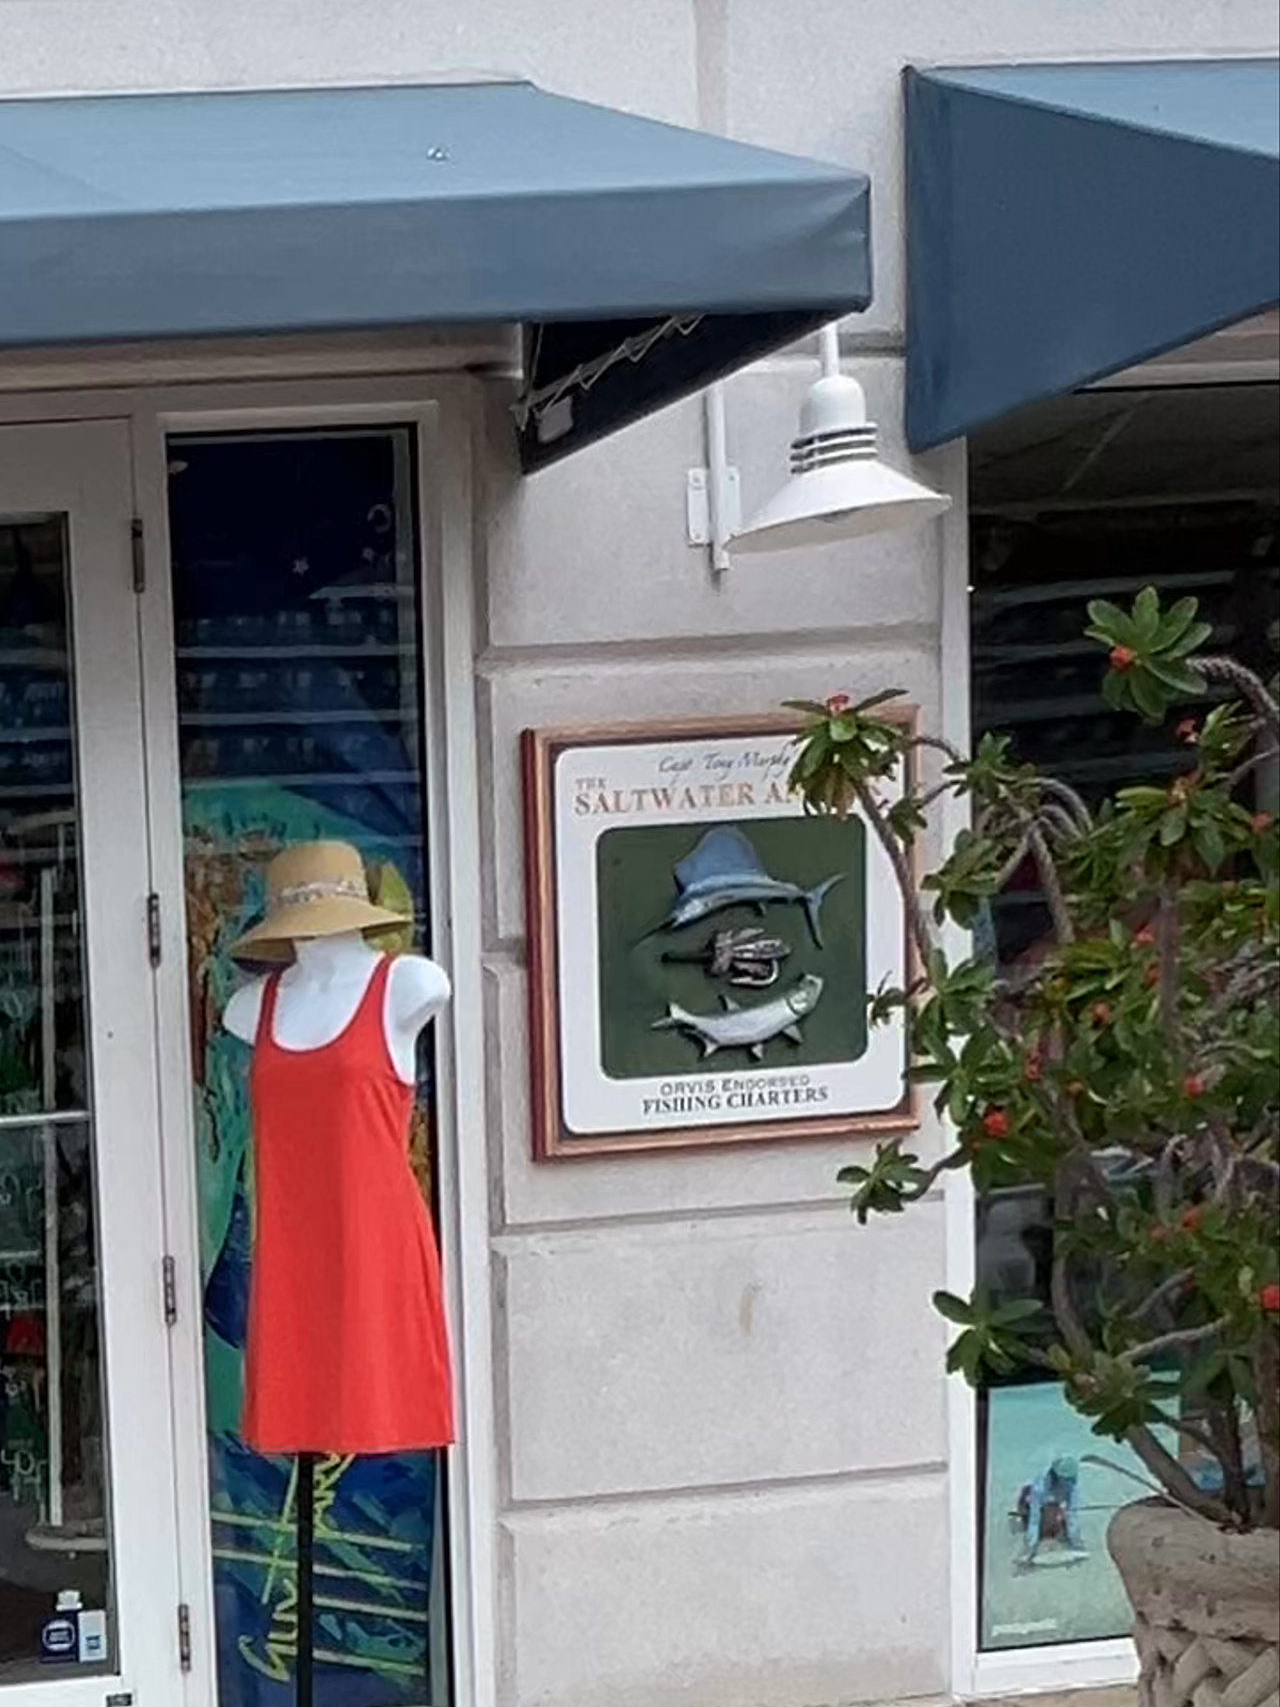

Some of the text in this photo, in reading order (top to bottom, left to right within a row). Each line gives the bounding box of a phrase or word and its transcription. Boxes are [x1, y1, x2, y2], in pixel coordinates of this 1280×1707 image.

[575, 777, 606, 791] THE
[574, 781, 755, 816] SALTWATER
[660, 1073, 811, 1097] ORVIS ENDORSED
[643, 1086, 829, 1115] FISHING CHARTERS
